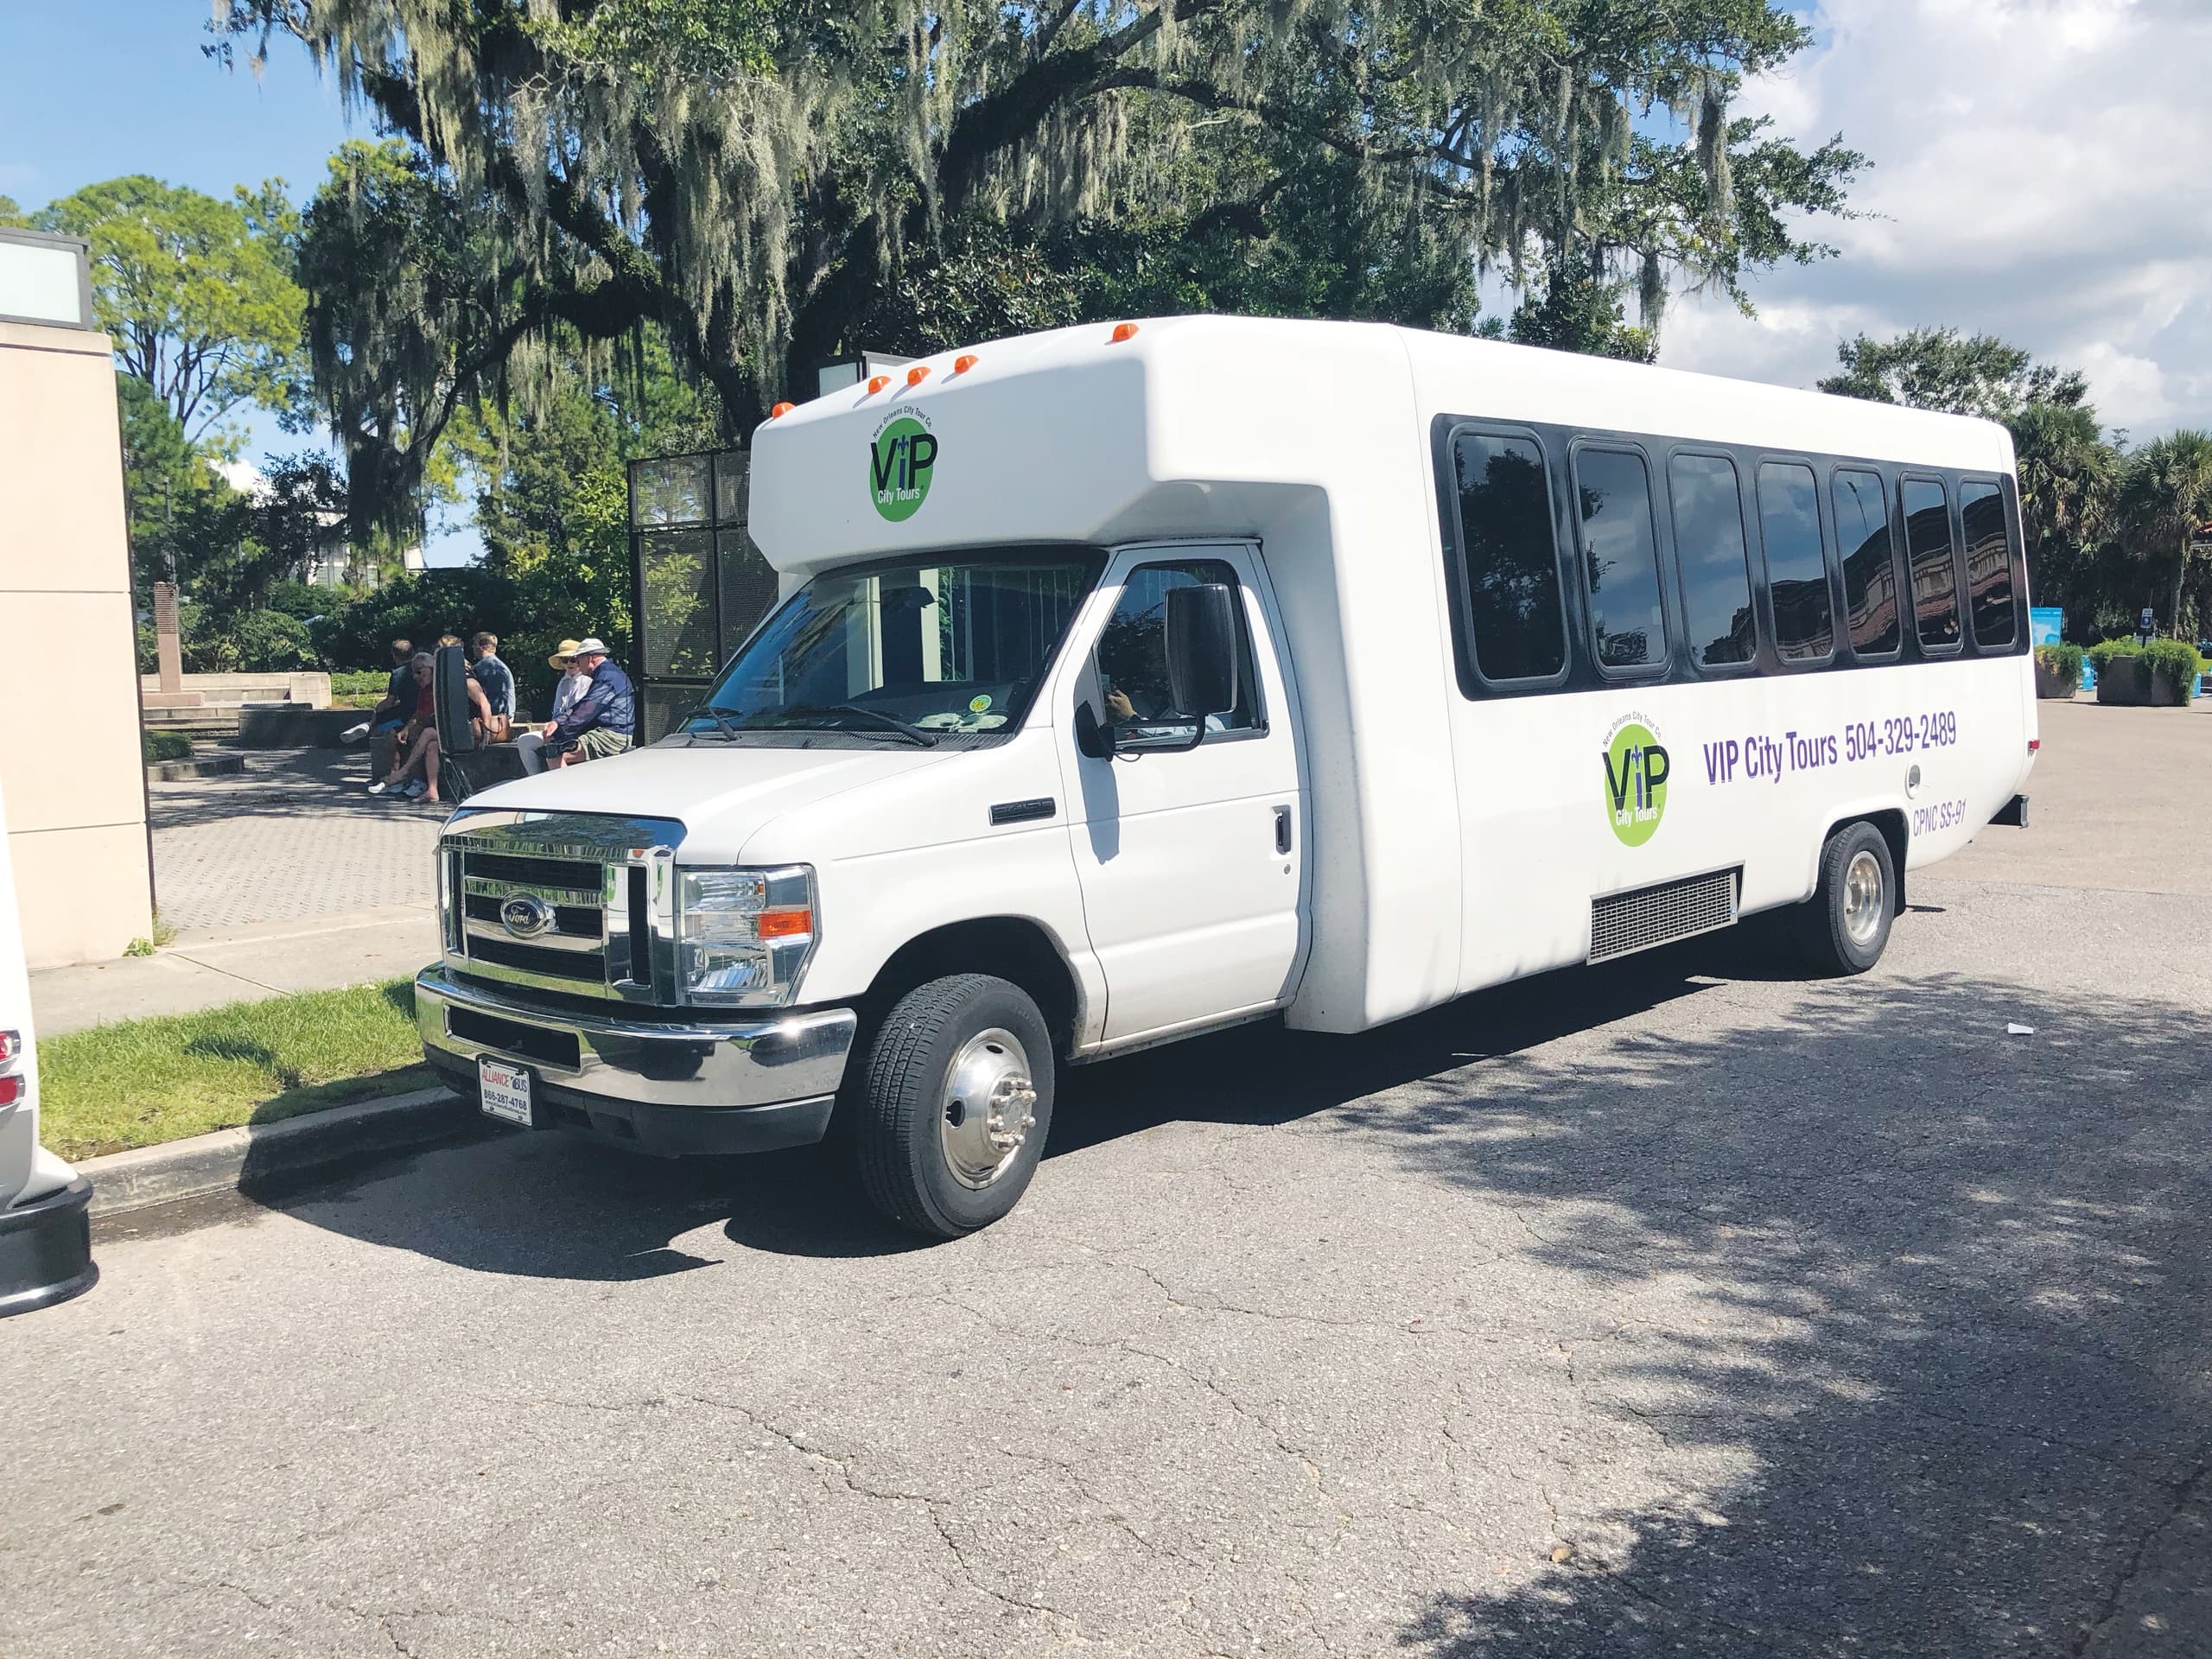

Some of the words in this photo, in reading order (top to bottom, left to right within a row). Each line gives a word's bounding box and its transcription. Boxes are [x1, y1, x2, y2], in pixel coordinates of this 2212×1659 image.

[873, 423, 883, 439] New
[883, 408, 903, 424] Orleans
[904, 405, 914, 416] City
[916, 407, 926, 420] Tour
[877, 489, 893, 505] City
[896, 486, 920, 502] Tours
[1603, 730, 1613, 747] New
[1611, 713, 1631, 731] Orleans
[1632, 710, 1643, 723] City
[1643, 714, 1655, 729] Tour
[1703, 739, 1739, 786] VIP
[1744, 735, 1783, 785] City
[1786, 730, 1838, 771] Tours
[1846, 710, 1956, 762] 504-329-2489
[1616, 809, 1632, 828] City
[1634, 805, 1658, 823] Tours
[1913, 804, 1938, 837] CPNC
[1940, 798, 1967, 830] SS-91
[508, 905, 531, 925] Ford
[482, 1068, 510, 1088] ALLIANCE
